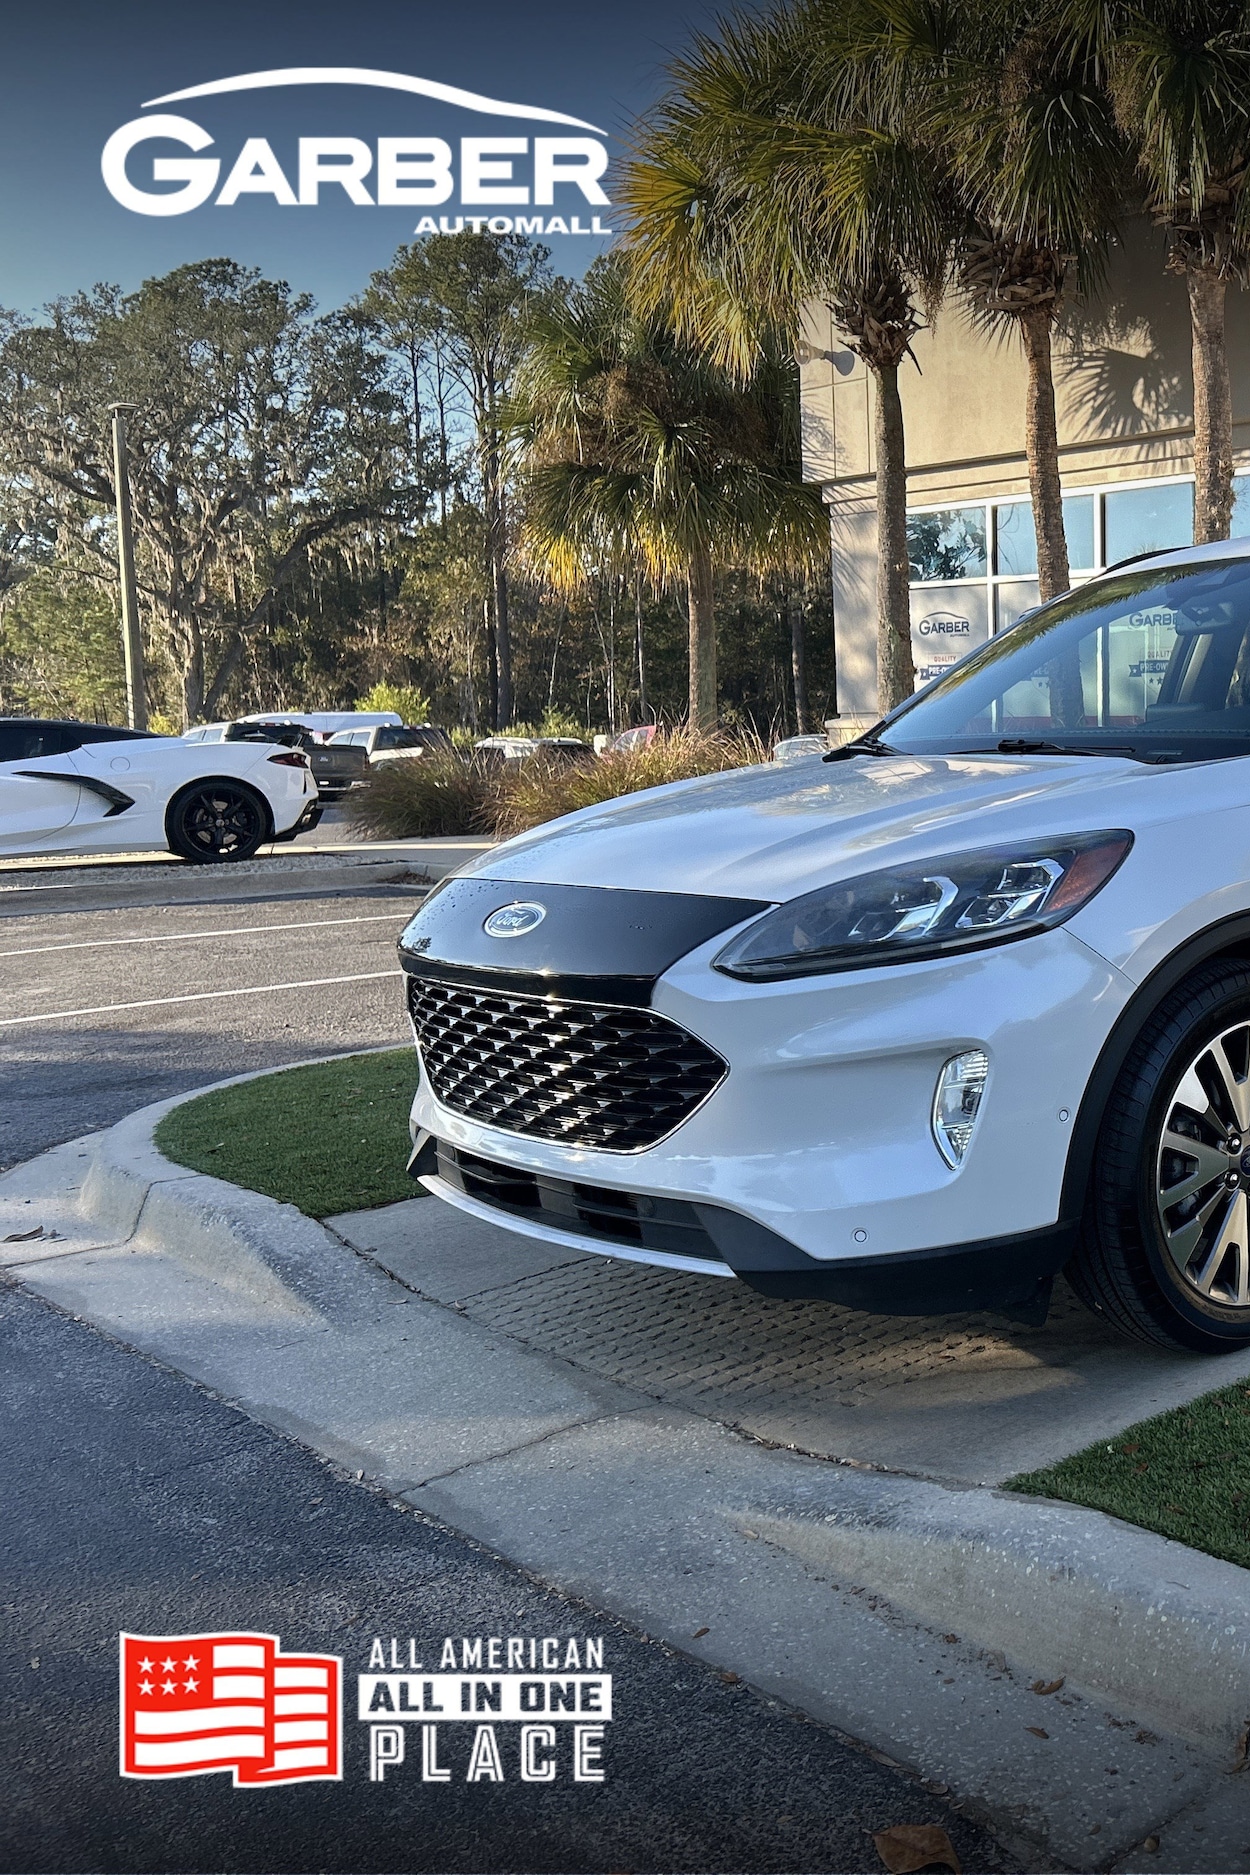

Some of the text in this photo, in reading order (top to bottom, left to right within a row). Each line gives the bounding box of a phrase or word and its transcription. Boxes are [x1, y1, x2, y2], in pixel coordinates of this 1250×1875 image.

[919, 619, 970, 636] GARBER
[933, 655, 957, 663] QUALITY
[496, 912, 529, 927] Ford
